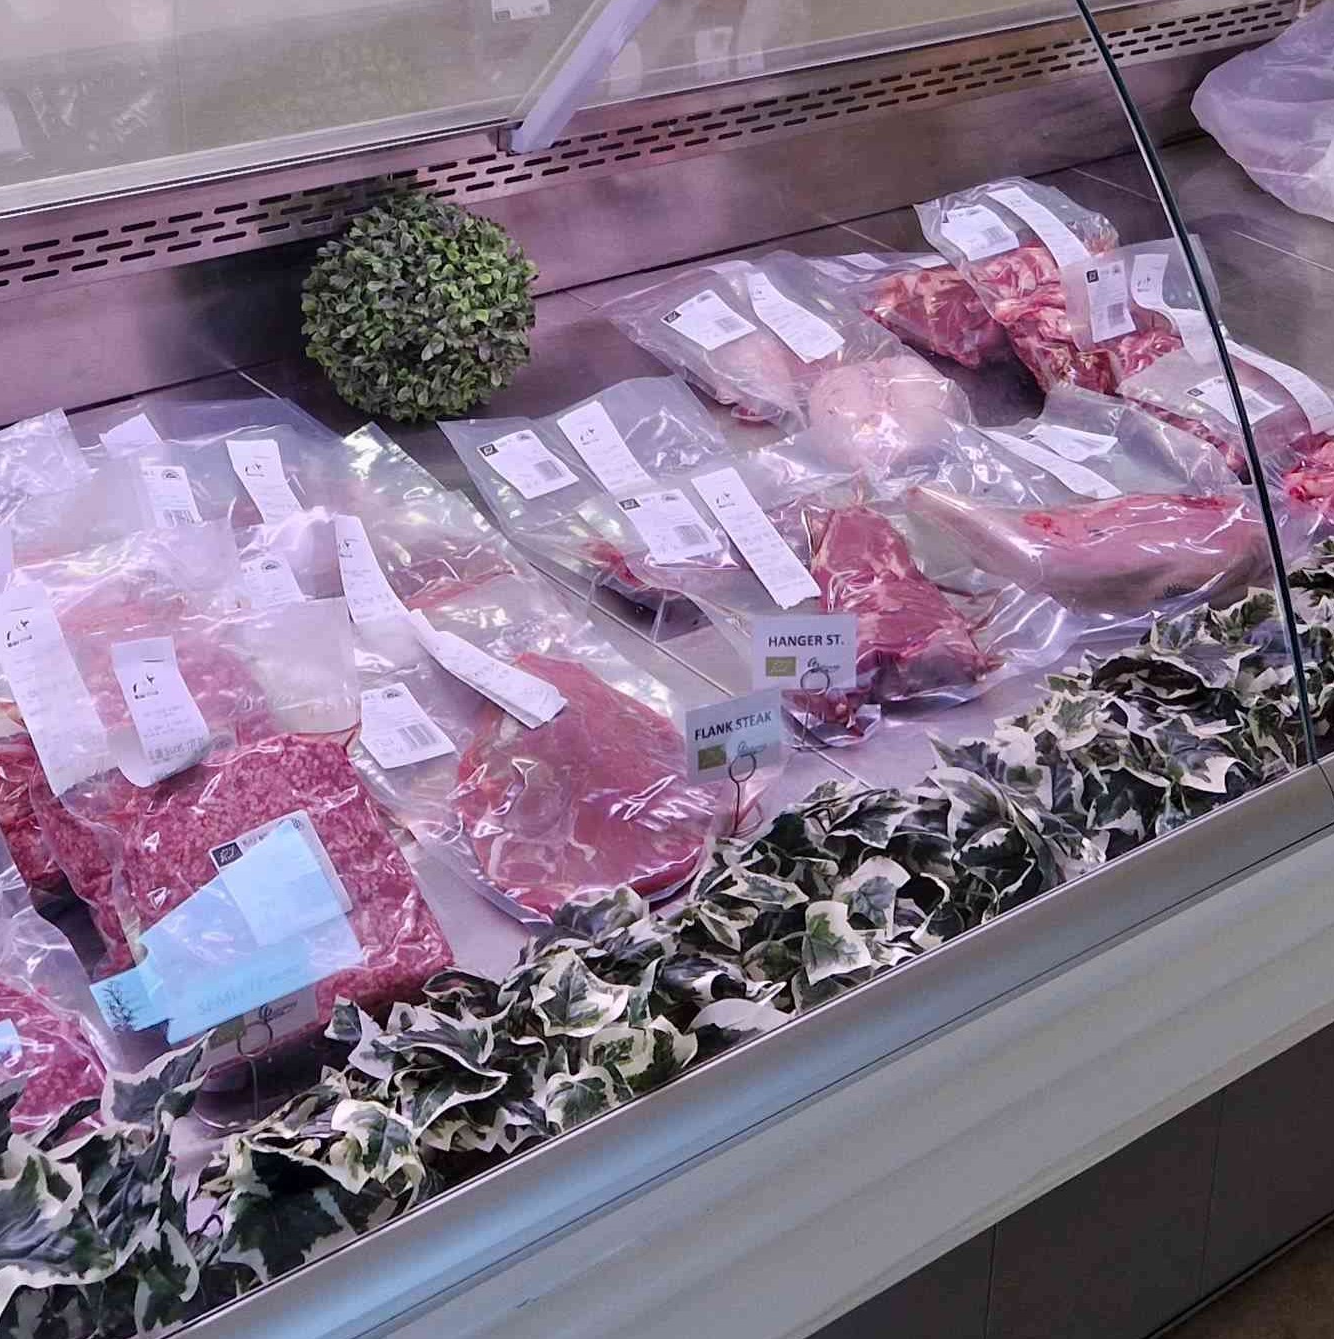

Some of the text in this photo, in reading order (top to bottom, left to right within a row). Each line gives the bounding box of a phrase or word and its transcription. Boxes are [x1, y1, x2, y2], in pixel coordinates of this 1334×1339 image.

[768, 633, 845, 648] HANGER ST.
[694, 710, 772, 741] FLANK STEAK
